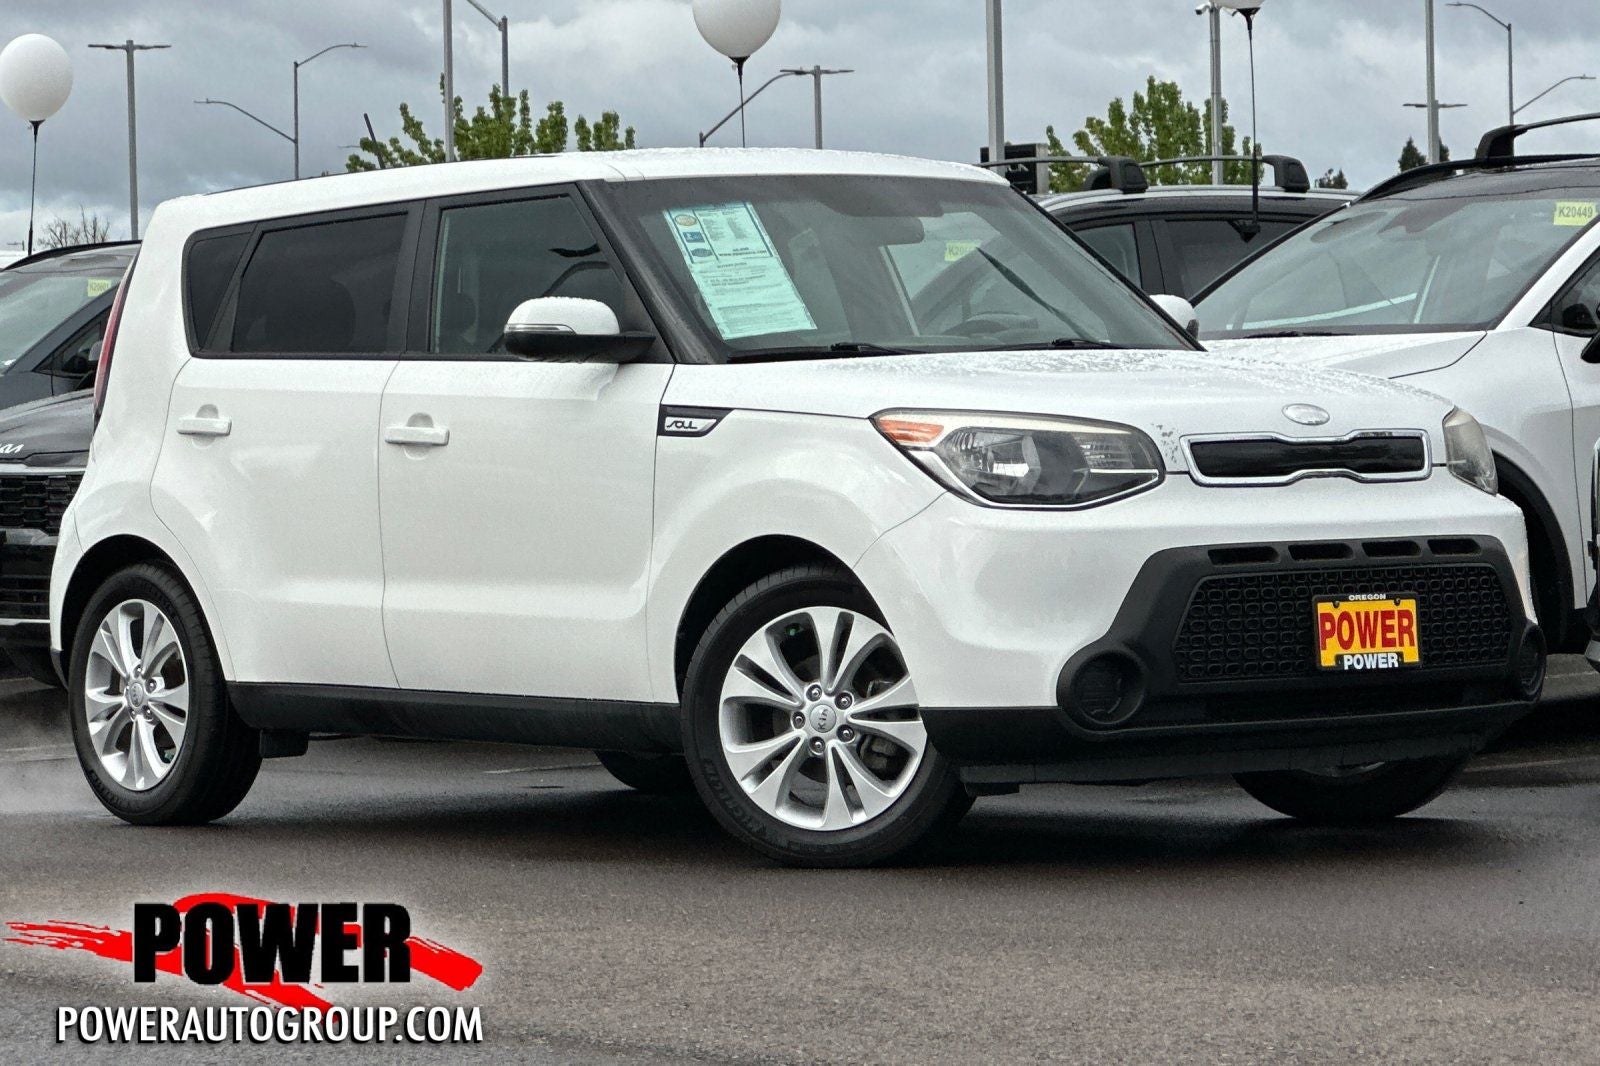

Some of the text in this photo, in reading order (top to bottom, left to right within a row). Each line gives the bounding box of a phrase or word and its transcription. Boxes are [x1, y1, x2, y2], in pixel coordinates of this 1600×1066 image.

[1558, 206, 1593, 218] K20449
[1348, 593, 1387, 601] OREGON
[1319, 609, 1415, 651] POWER
[1343, 652, 1399, 670] POWER
[818, 708, 828, 730] KIA
